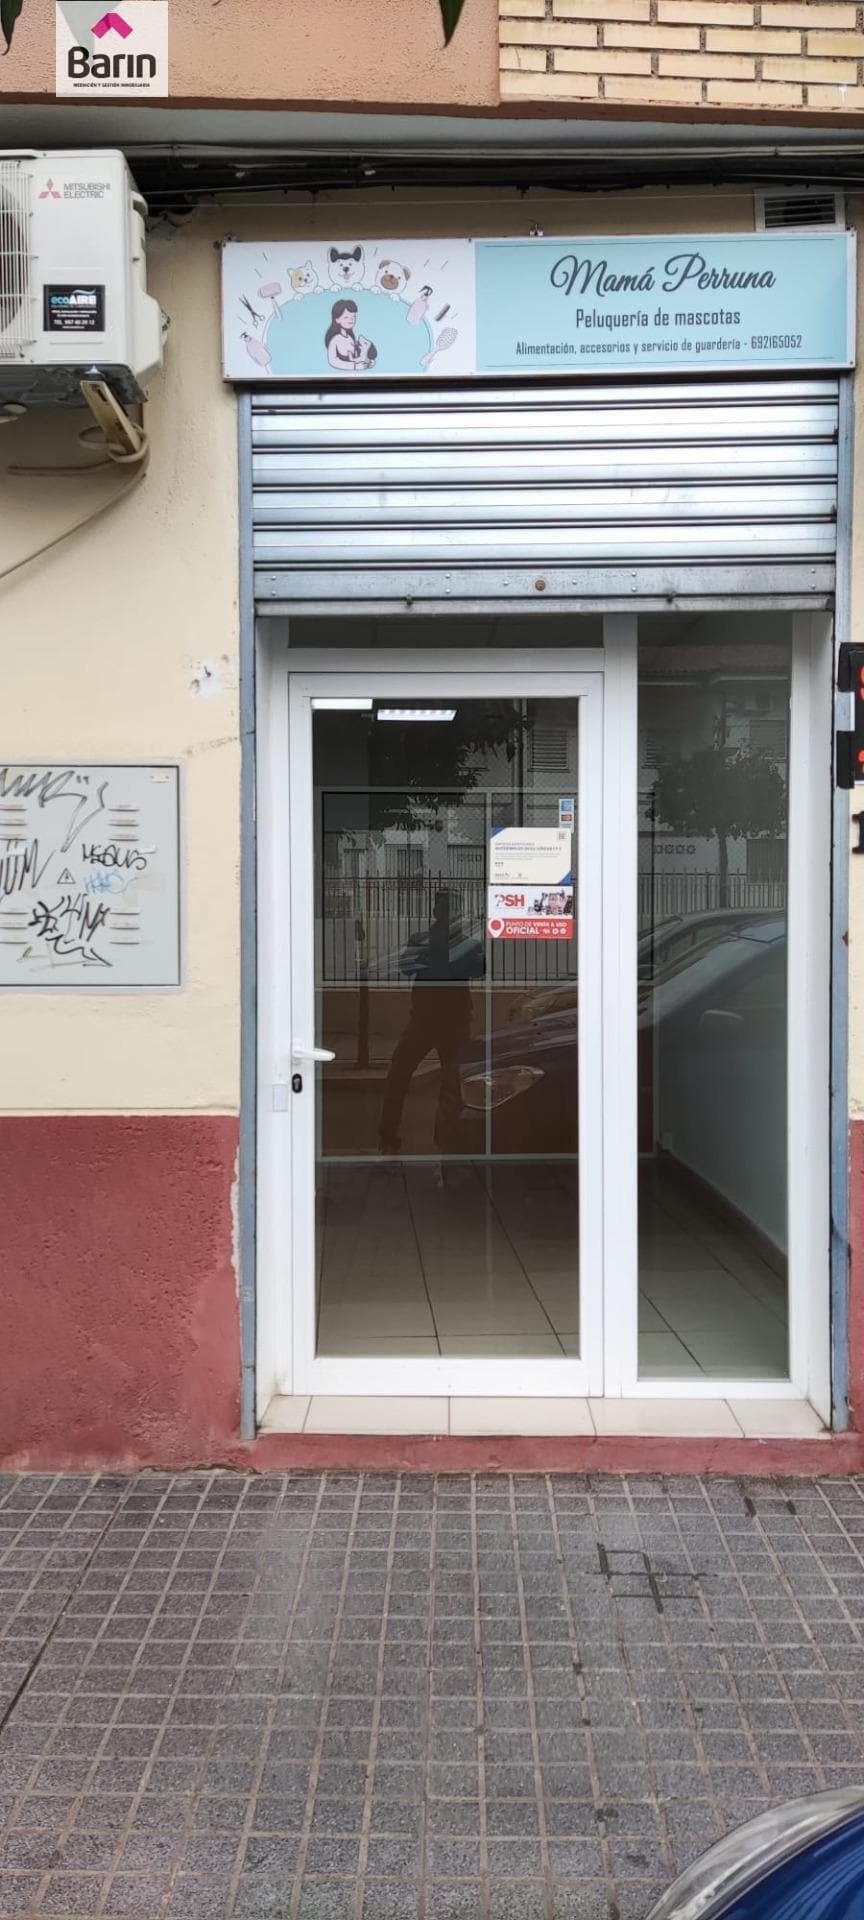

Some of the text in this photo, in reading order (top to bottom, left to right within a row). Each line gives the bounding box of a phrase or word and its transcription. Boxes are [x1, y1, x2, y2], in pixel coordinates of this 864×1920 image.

[63, 182, 111, 191] MITSUBISHI
[63, 190, 105, 199] ELECTRIC
[550, 253, 776, 296] Mamá Perruna
[576, 307, 741, 332] Peluquería de mascotas
[516, 340, 577, 355] Alimentación,
[580, 341, 630, 354] accesorios
[633, 343, 639, 355] y
[641, 339, 679, 352] servicio
[681, 339, 692, 352] de
[695, 338, 741, 353] guardería
[750, 335, 802, 350] 692165052
[506, 927, 541, 935] OFICIAL
